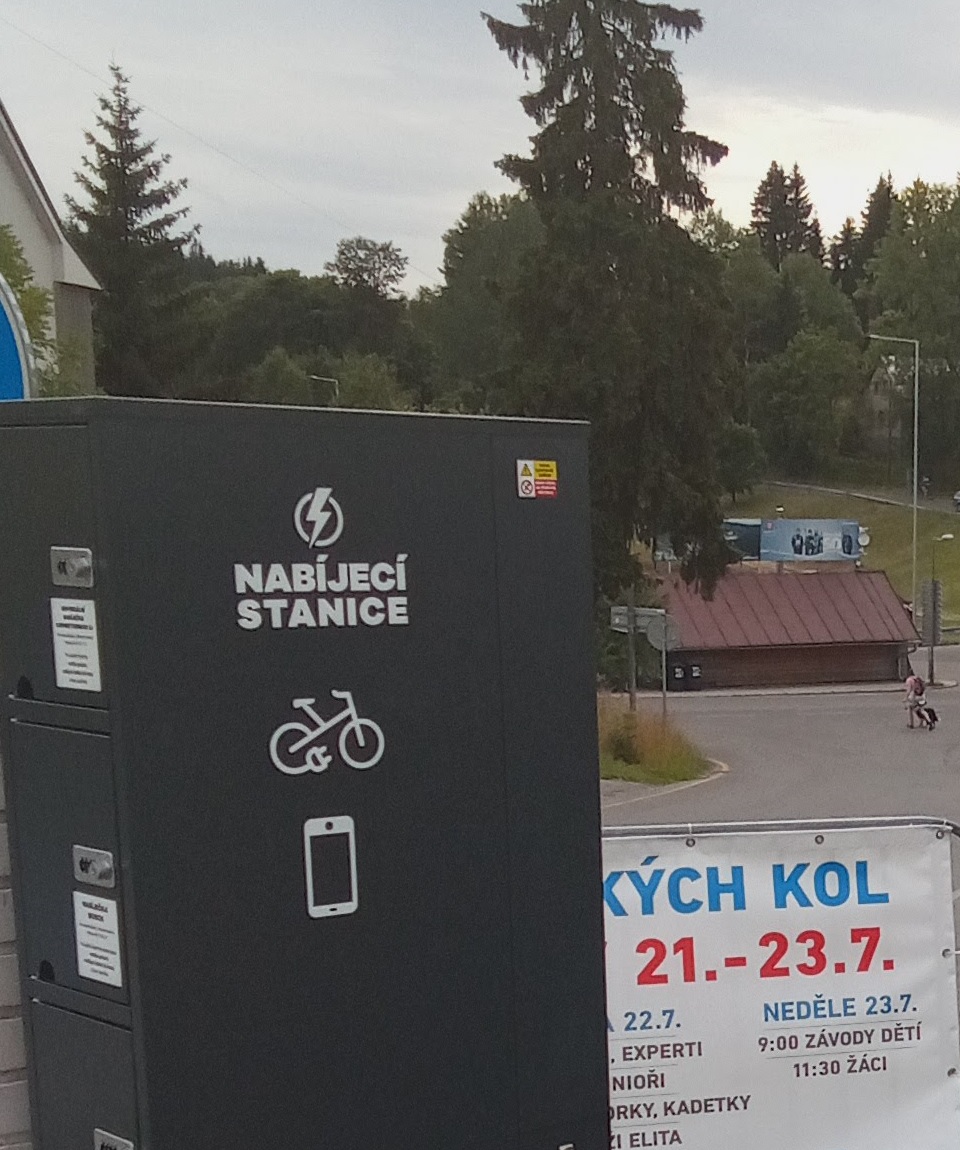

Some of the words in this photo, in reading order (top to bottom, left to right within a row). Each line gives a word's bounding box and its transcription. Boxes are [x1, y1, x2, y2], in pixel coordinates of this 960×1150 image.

[233, 554, 409, 593] NABÍJECÍ
[237, 596, 409, 630] STANICE
[772, 860, 890, 910] KOL
[623, 1009, 682, 1032] 22.7.
[763, 994, 856, 1023] NEDĚLE
[865, 994, 918, 1016] 23.7.
[758, 1034, 799, 1054] 9:00
[805, 1028, 875, 1050] ZÁVODY
[881, 1021, 922, 1044] DĚTÍ
[622, 1041, 703, 1062] EXPERTI
[793, 1060, 841, 1078] 11:30
[847, 1053, 887, 1075] ŽÁCI
[663, 1095, 752, 1117] KADETKY
[629, 1130, 683, 1149] ELITA
